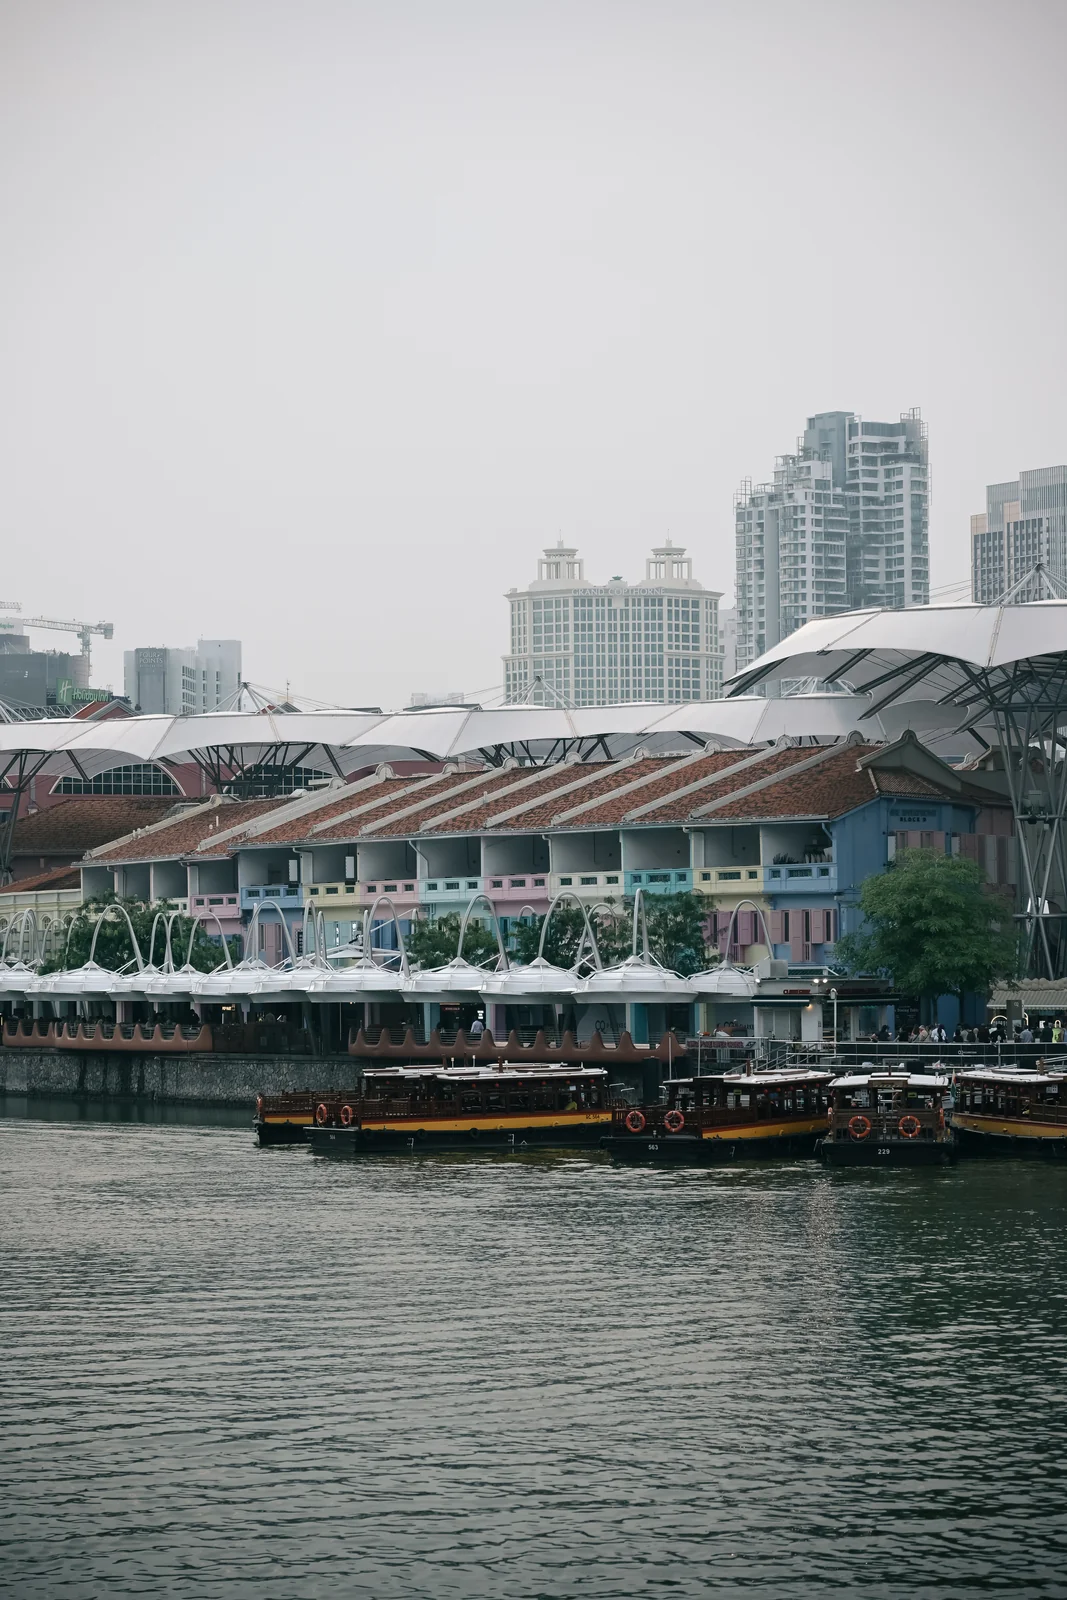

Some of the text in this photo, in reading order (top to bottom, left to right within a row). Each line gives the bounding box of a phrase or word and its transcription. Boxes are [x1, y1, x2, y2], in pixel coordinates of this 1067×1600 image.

[571, 587, 665, 596] GRAND COPTHORNE
[72, 688, 109, 702] Holiday Inn
